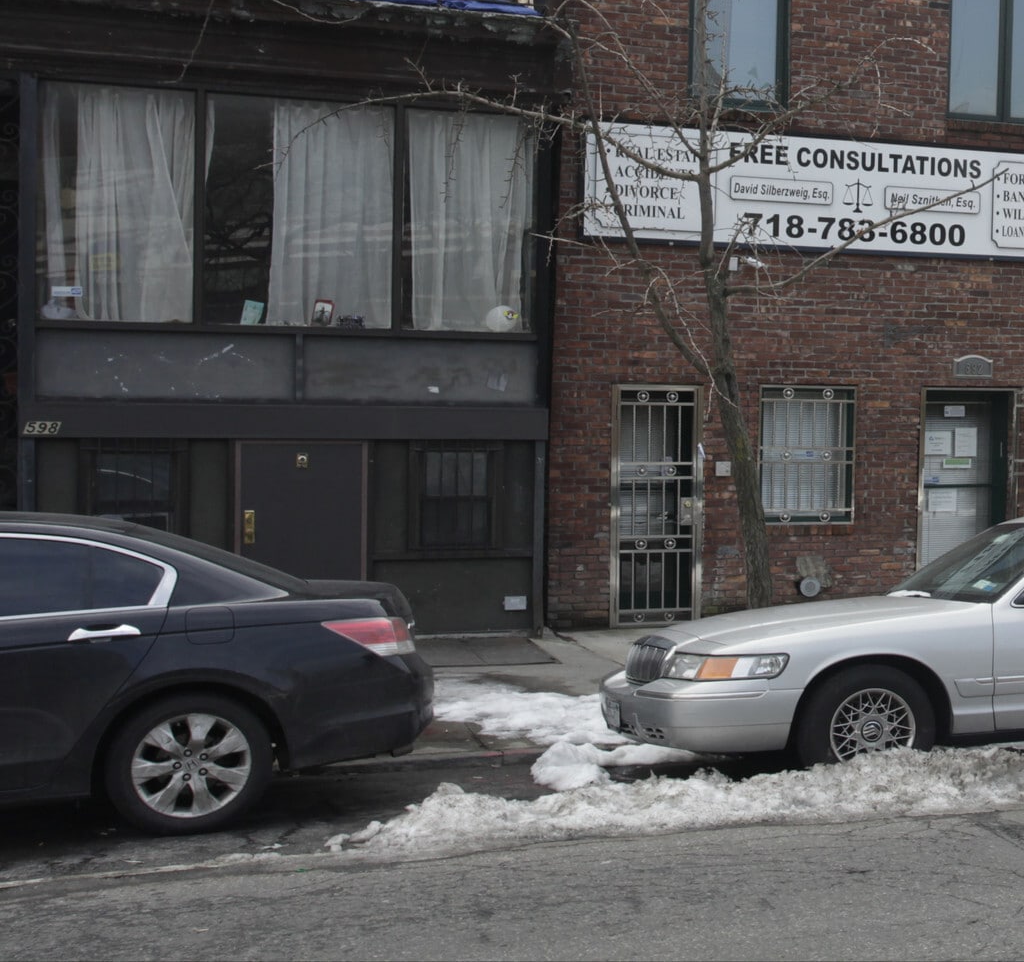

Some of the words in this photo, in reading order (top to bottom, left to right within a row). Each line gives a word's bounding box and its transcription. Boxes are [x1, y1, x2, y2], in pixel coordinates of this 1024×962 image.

[730, 142, 788, 165] FREE
[797, 147, 982, 179] CONSULTATIONS
[615, 184, 678, 199] DIVORCE
[734, 182, 758, 195] David
[761, 184, 811, 201] Silberzweig,
[812, 187, 830, 201] Esq.
[956, 197, 976, 211] Esq.
[744, 212, 965, 247] 718-783-6800
[1002, 226, 1024, 238] LOAN
[26, 422, 58, 433] 598
